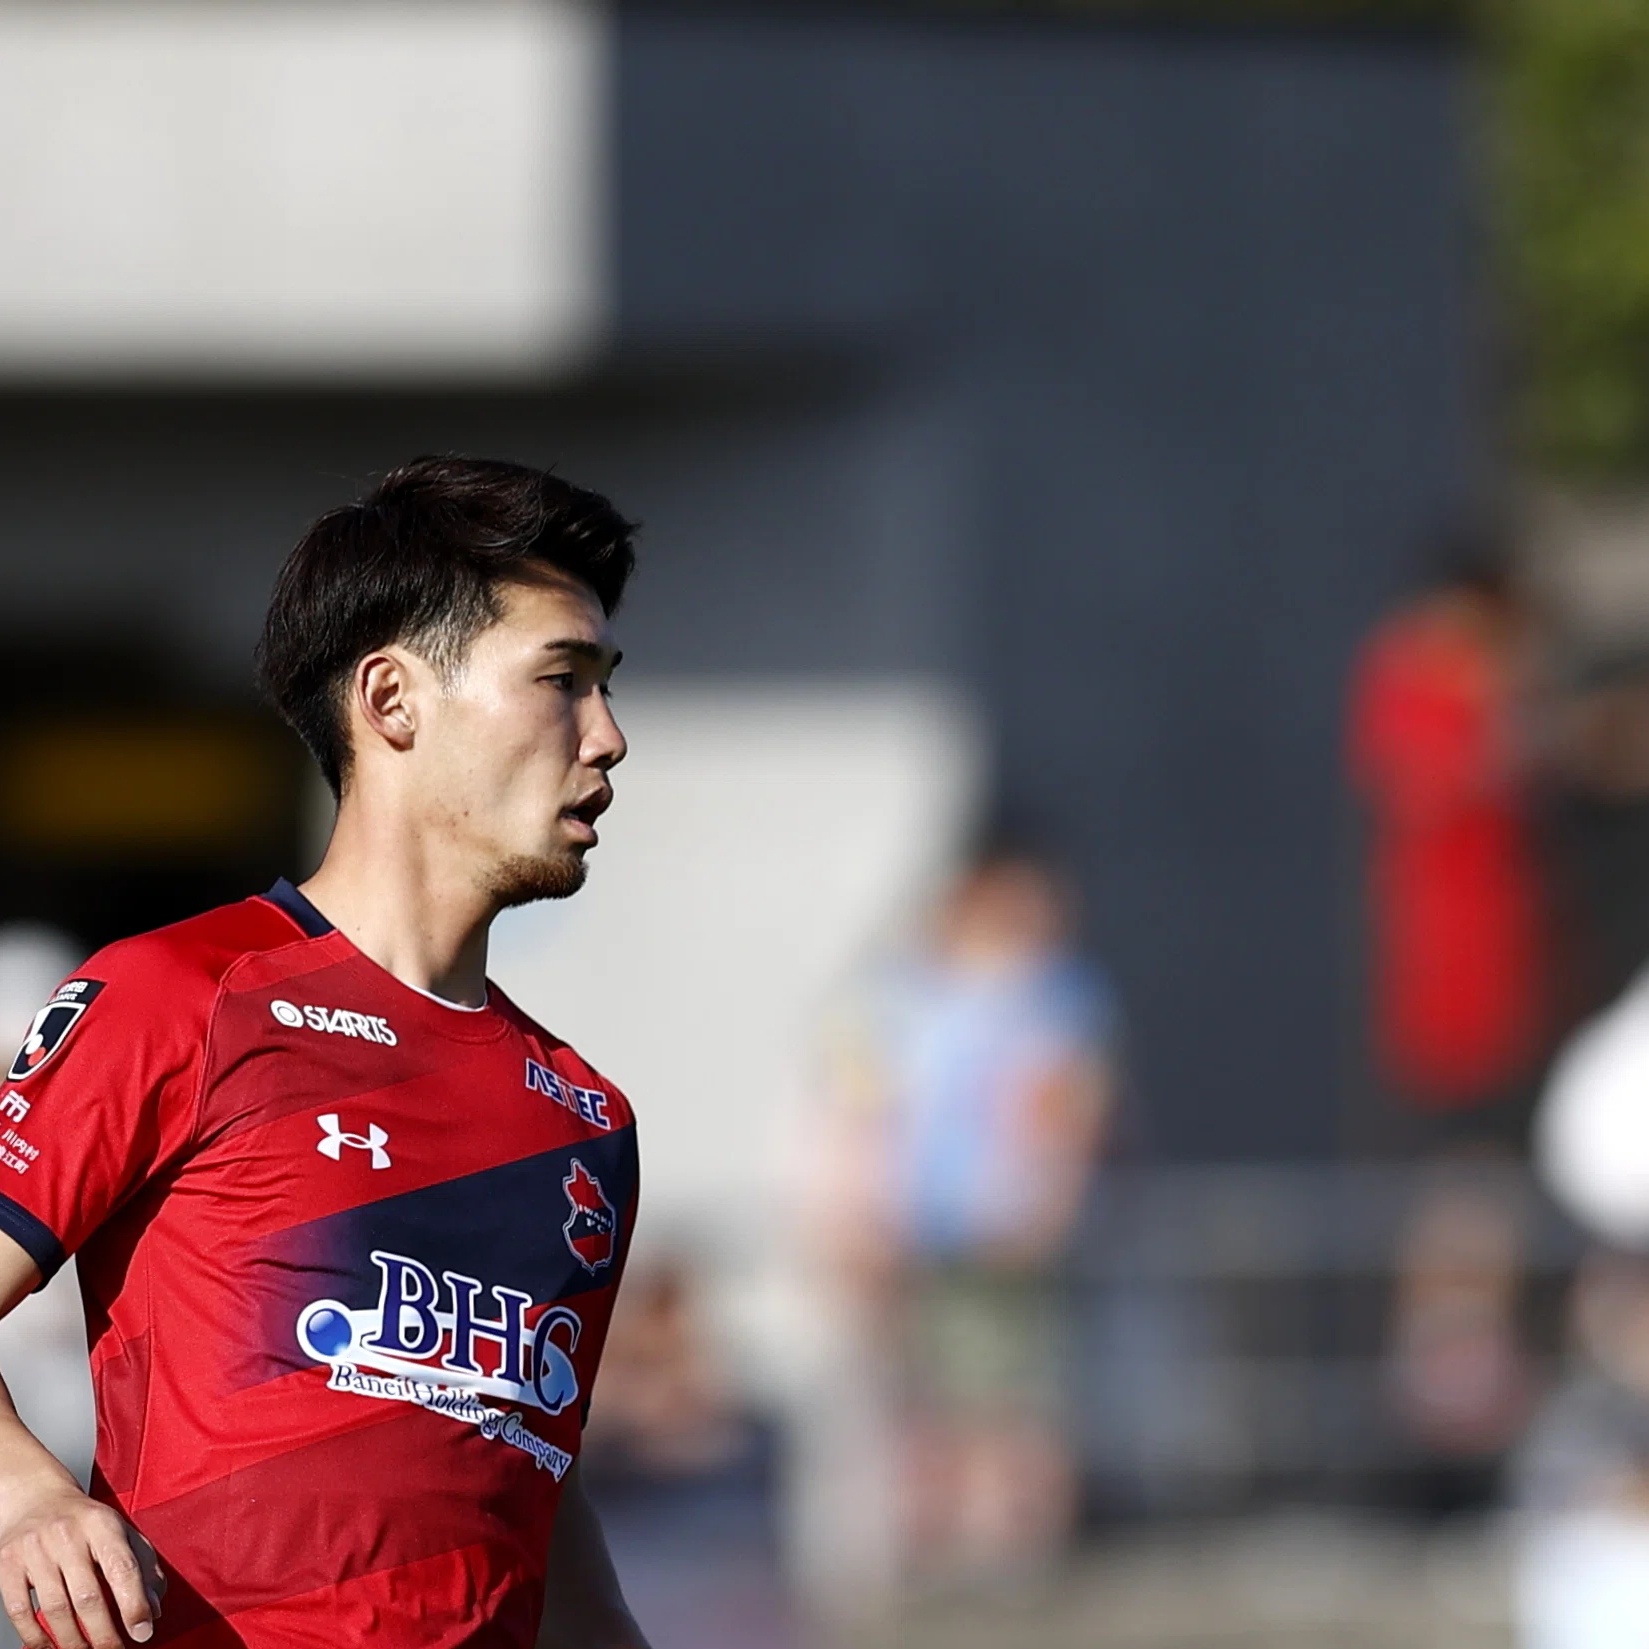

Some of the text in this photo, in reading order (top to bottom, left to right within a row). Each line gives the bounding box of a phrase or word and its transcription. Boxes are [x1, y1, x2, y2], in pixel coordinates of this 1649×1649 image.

[303, 1005, 398, 1047] STARTS
[525, 1057, 611, 1131] ASTEC
[1, 1128, 40, 1161] 川内村
[578, 1203, 612, 1229] IWAKI
[586, 1217, 606, 1235] FC
[362, 1250, 582, 1416] BHC
[331, 1364, 404, 1398] Banei
[501, 1412, 571, 1480] Company
